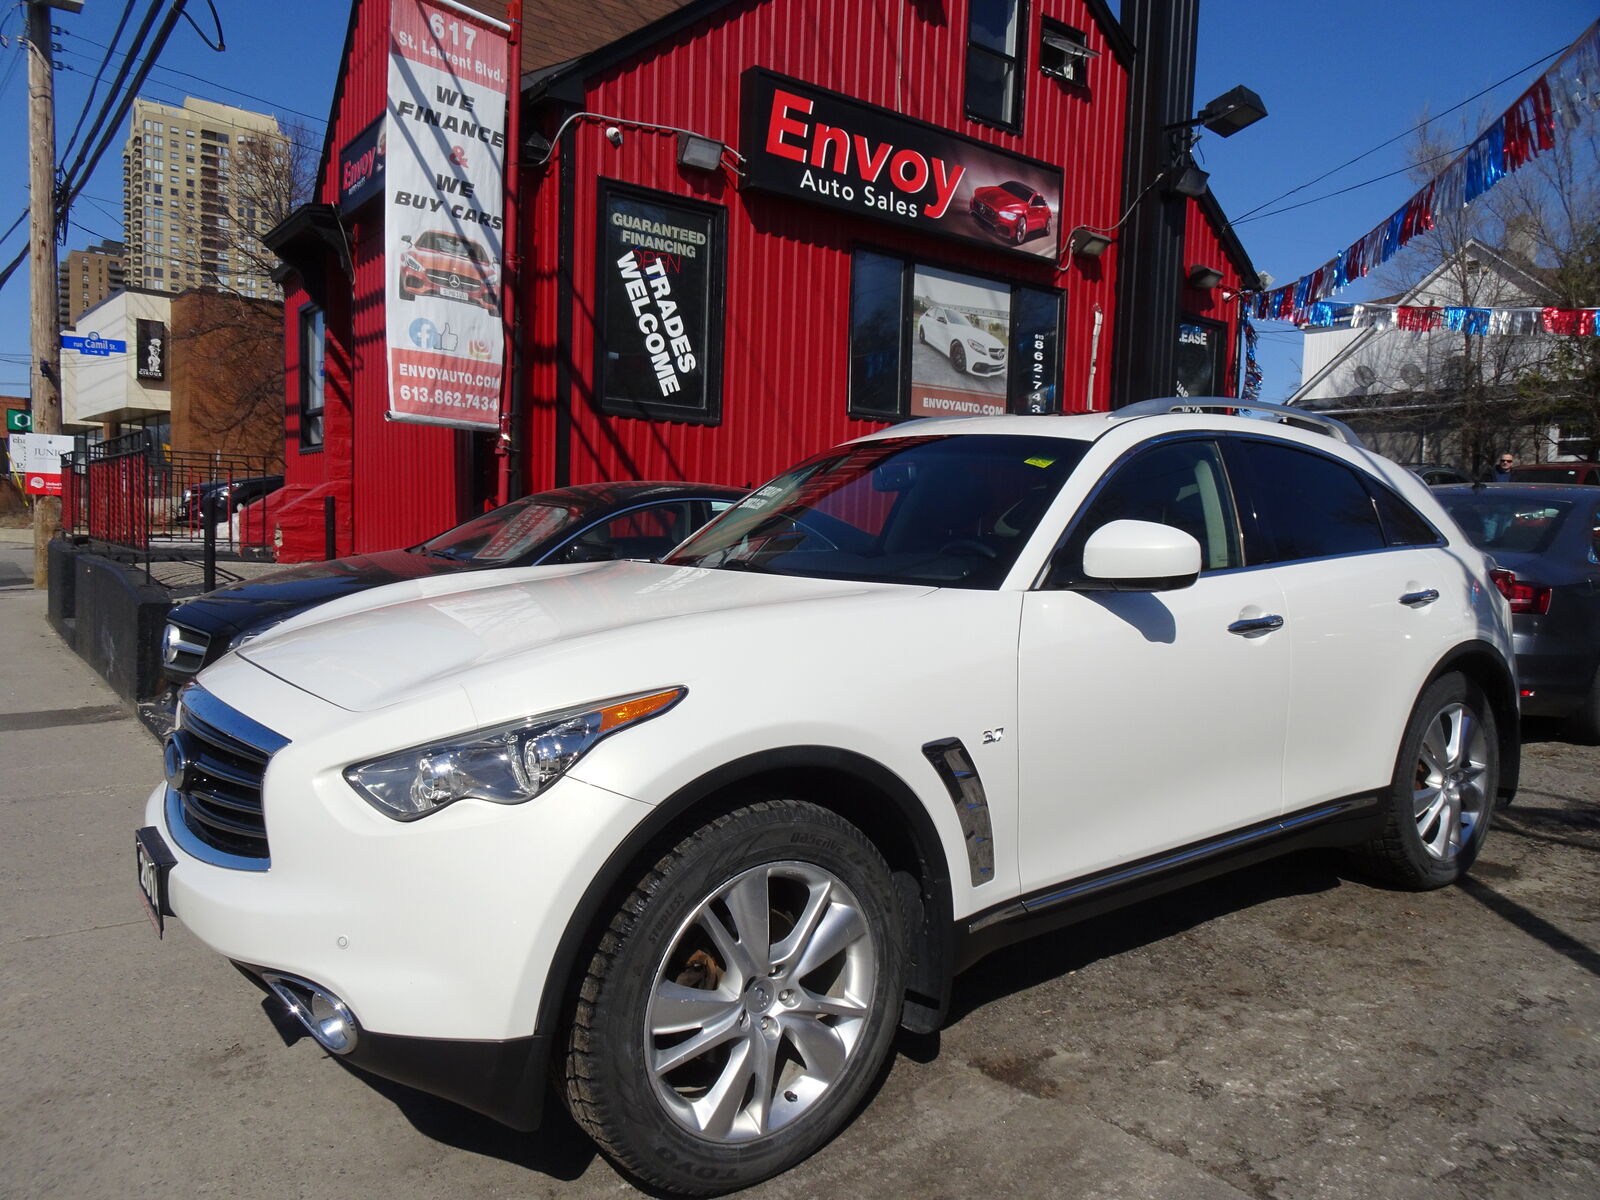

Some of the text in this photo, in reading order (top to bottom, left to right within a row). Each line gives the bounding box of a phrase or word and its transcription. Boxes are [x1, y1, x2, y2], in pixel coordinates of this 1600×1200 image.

[430, 13, 477, 51] 617
[399, 31, 504, 83] St. Laurent Blvd.
[436, 85, 475, 113] WE
[396, 100, 504, 149] FINANCE
[450, 145, 469, 168] &
[765, 88, 966, 219] Envoy
[436, 174, 475, 199] WE
[800, 169, 918, 218] Auto Sales
[395, 190, 503, 230] BUY CARS
[612, 212, 707, 246] GUARANTEED
[622, 229, 696, 258] FINANCING
[617, 250, 681, 397] WELCOME
[645, 257, 697, 374] TRADES
[84, 339, 109, 350] Camil
[1179, 332, 1207, 345] EASE
[399, 363, 500, 389] ENVOYAUTO.COM
[400, 385, 498, 411] 613.862.7434
[923, 397, 1004, 416] ENVOYAUTO.COM
